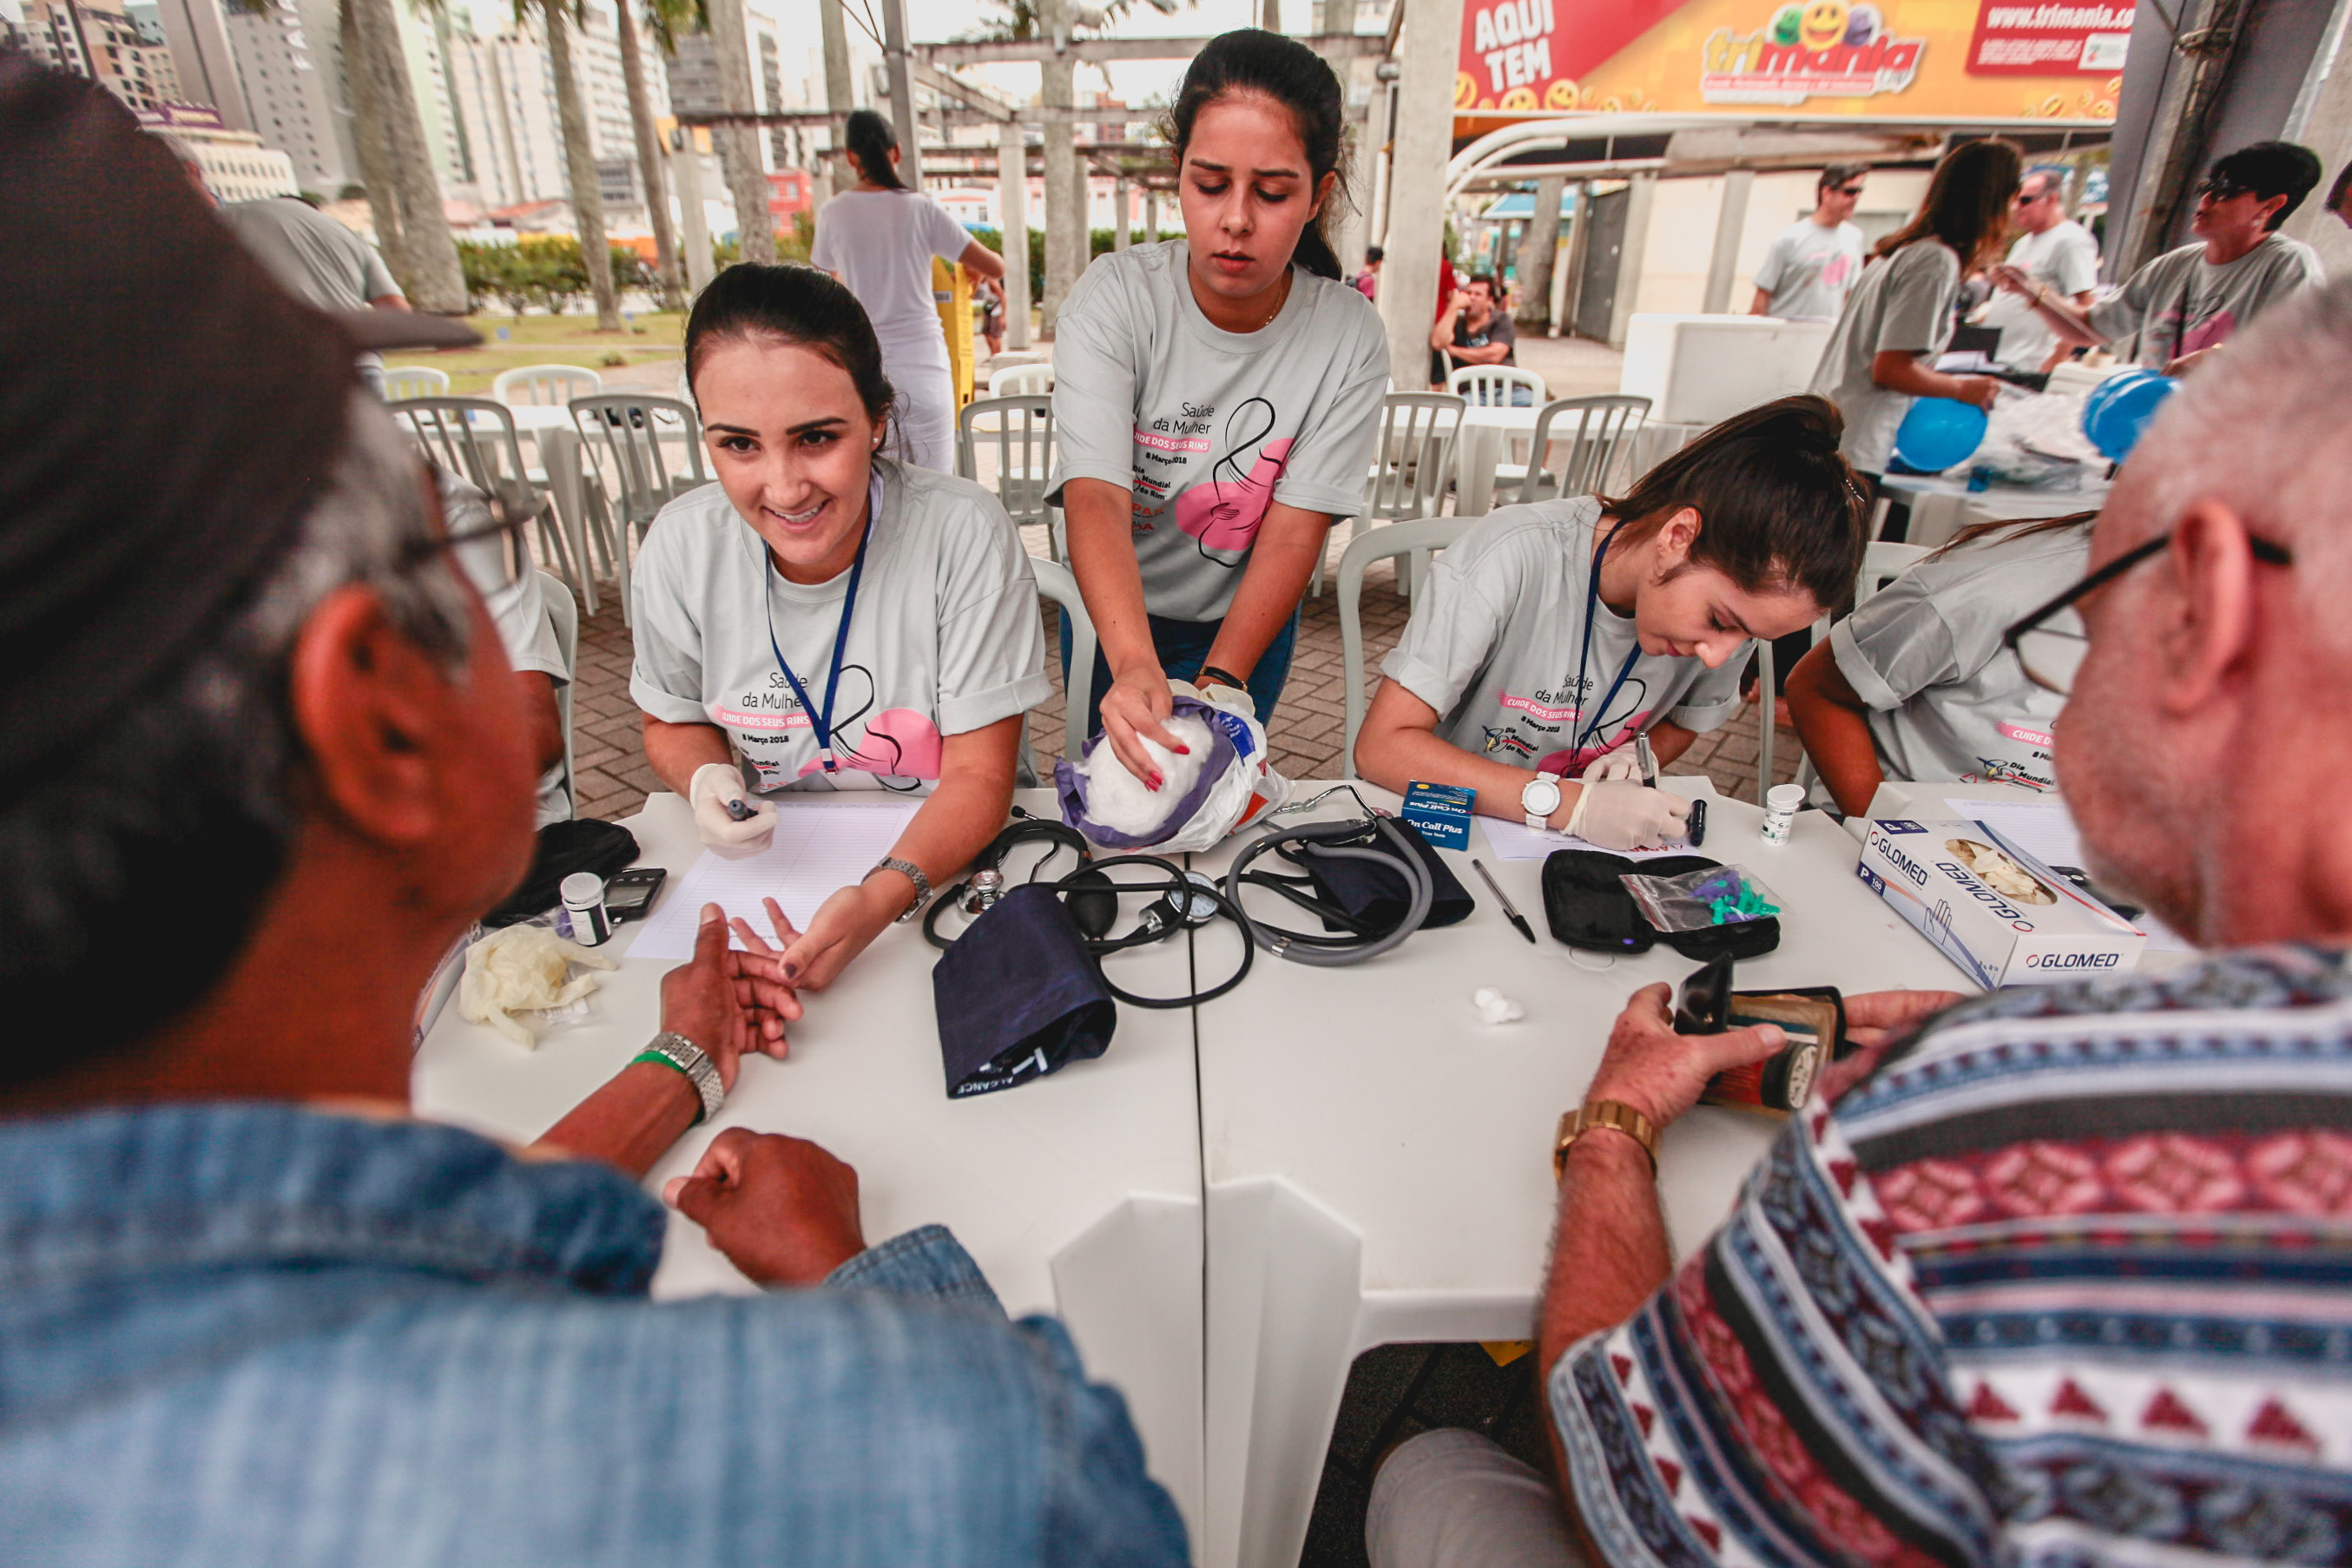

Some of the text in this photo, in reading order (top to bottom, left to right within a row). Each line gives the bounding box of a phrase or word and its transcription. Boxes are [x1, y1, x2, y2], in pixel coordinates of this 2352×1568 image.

[1474, 0, 1554, 54] AQUI
[1706, 33, 1920, 73] trimania
[1484, 36, 1552, 94] TEM
[1181, 402, 1215, 418] Saúde
[1153, 418, 1211, 434] da Mulher
[1151, 438, 1169, 448] DOS
[1170, 440, 1188, 451] SEUS
[1189, 441, 1209, 451] RINS
[1152, 454, 1172, 465] Março
[1142, 475, 1170, 488] Mundial
[1150, 491, 1164, 499] Rim
[742, 692, 802, 708] da Mulhe
[1535, 689, 1551, 702] da
[1507, 699, 1530, 708] CUIDE
[1530, 705, 1547, 717] DOS
[742, 716, 761, 726] DOS
[762, 717, 785, 727] SEUS
[787, 715, 809, 725] RINS
[1526, 717, 1545, 732] Março
[748, 735, 768, 745] Março
[1511, 735, 1538, 752] Mundial
[2013, 730, 2043, 743] CUIDE
[2018, 772, 2054, 786] Mundial
[1421, 821, 1441, 831] Call
[1442, 824, 1464, 834] Plus
[1878, 838, 1927, 886] GLOMED
[1860, 866, 1869, 878] P
[1872, 878, 1882, 890] 100
[1935, 862, 2020, 919] GLOMED
[2041, 953, 2119, 968] GLOMED
